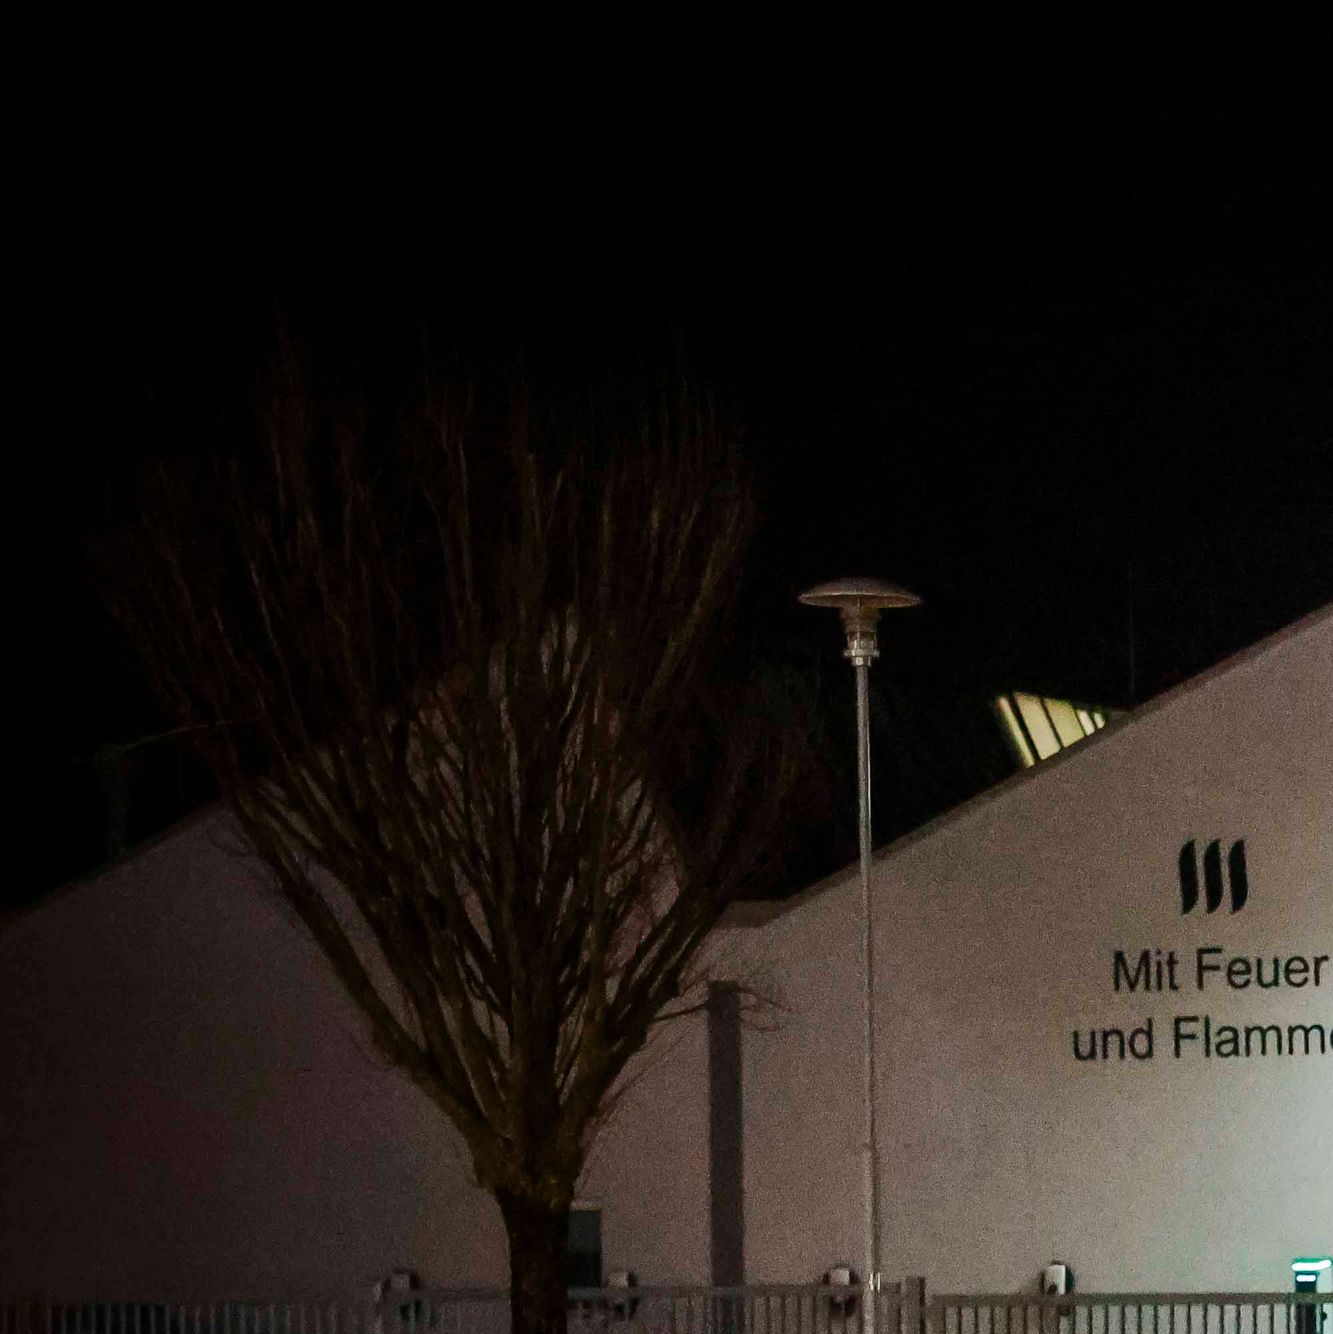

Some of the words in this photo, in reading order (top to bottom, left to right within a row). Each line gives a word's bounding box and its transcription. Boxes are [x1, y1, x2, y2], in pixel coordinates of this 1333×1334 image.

[1113, 948, 1179, 993] Mit
[1196, 948, 1330, 990] Feuer
[1072, 1019, 1155, 1061] und
